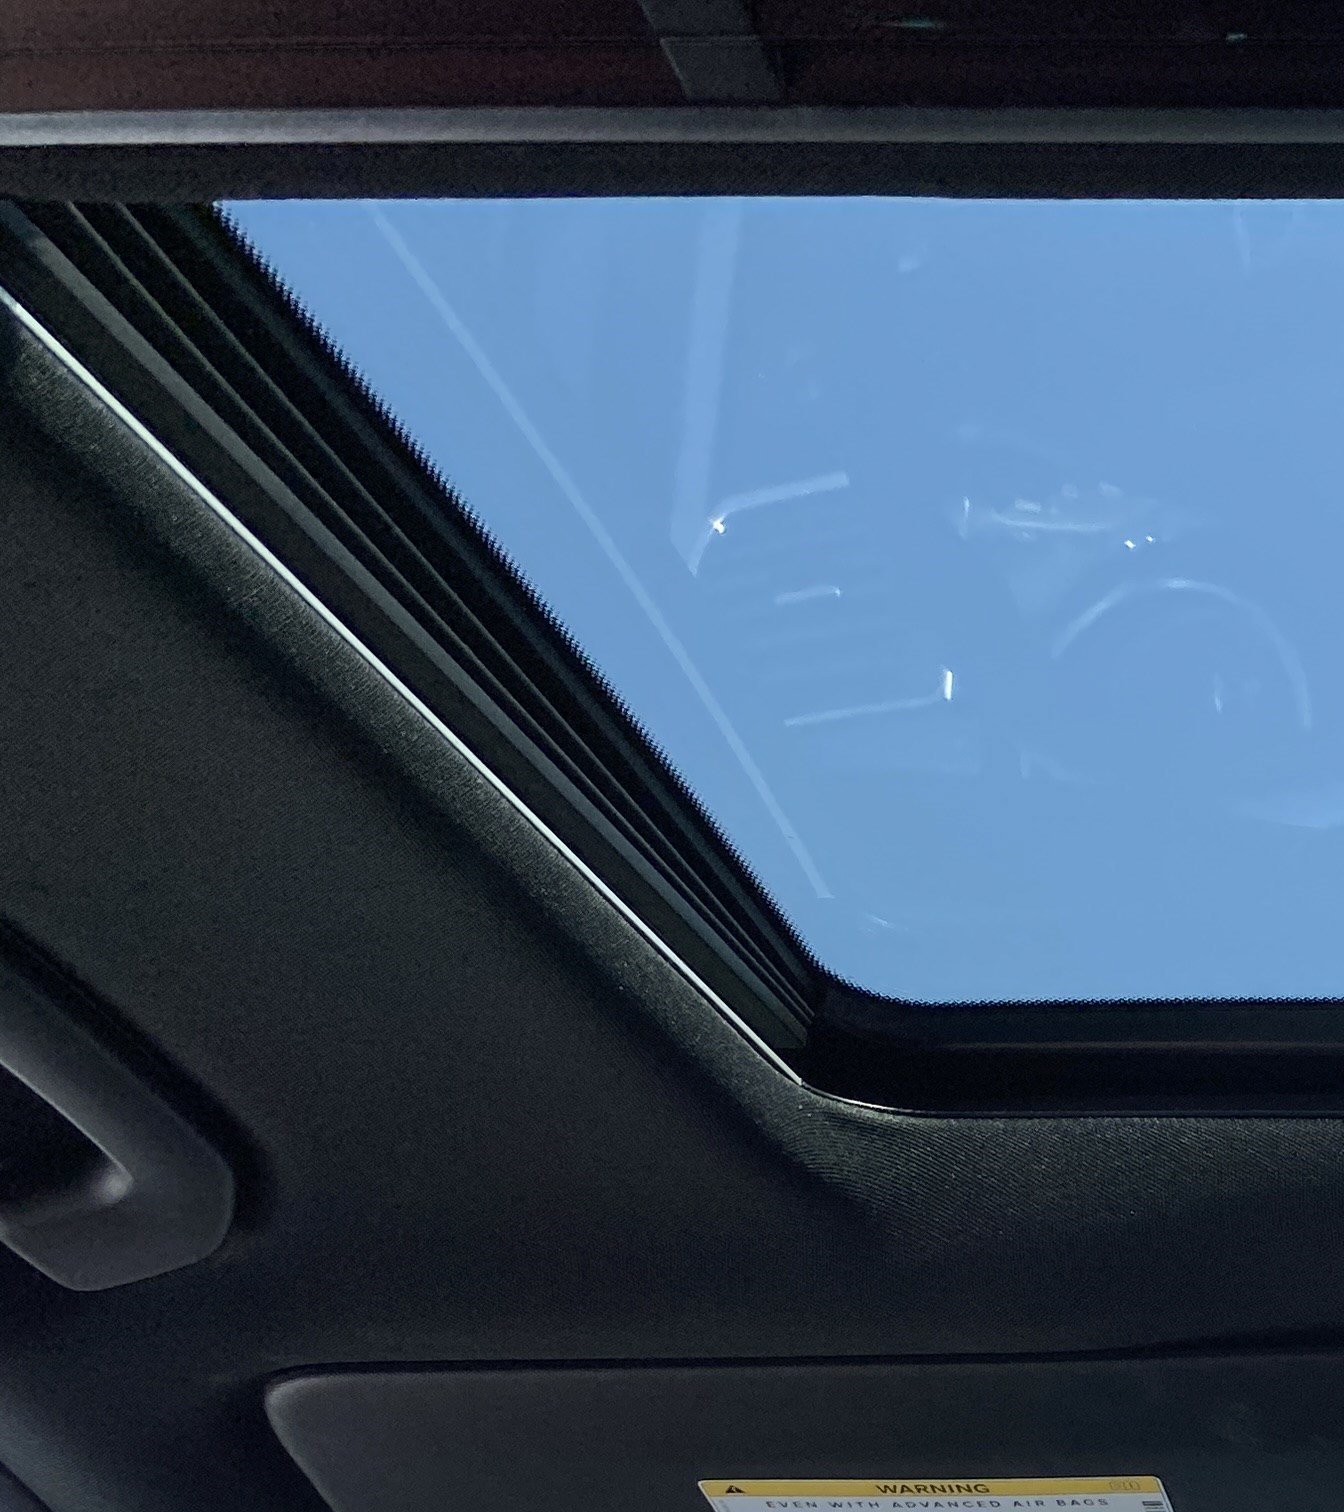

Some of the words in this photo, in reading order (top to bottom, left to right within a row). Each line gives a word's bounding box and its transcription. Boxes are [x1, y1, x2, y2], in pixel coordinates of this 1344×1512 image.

[875, 1483, 991, 1495] WARNING
[766, 1500, 819, 1509] EVEN
[828, 1500, 881, 1509] WITH
[893, 1499, 1002, 1509] ADVANCED
[1013, 1499, 1046, 1508] AIR
[1056, 1498, 1111, 1508] BAGS
